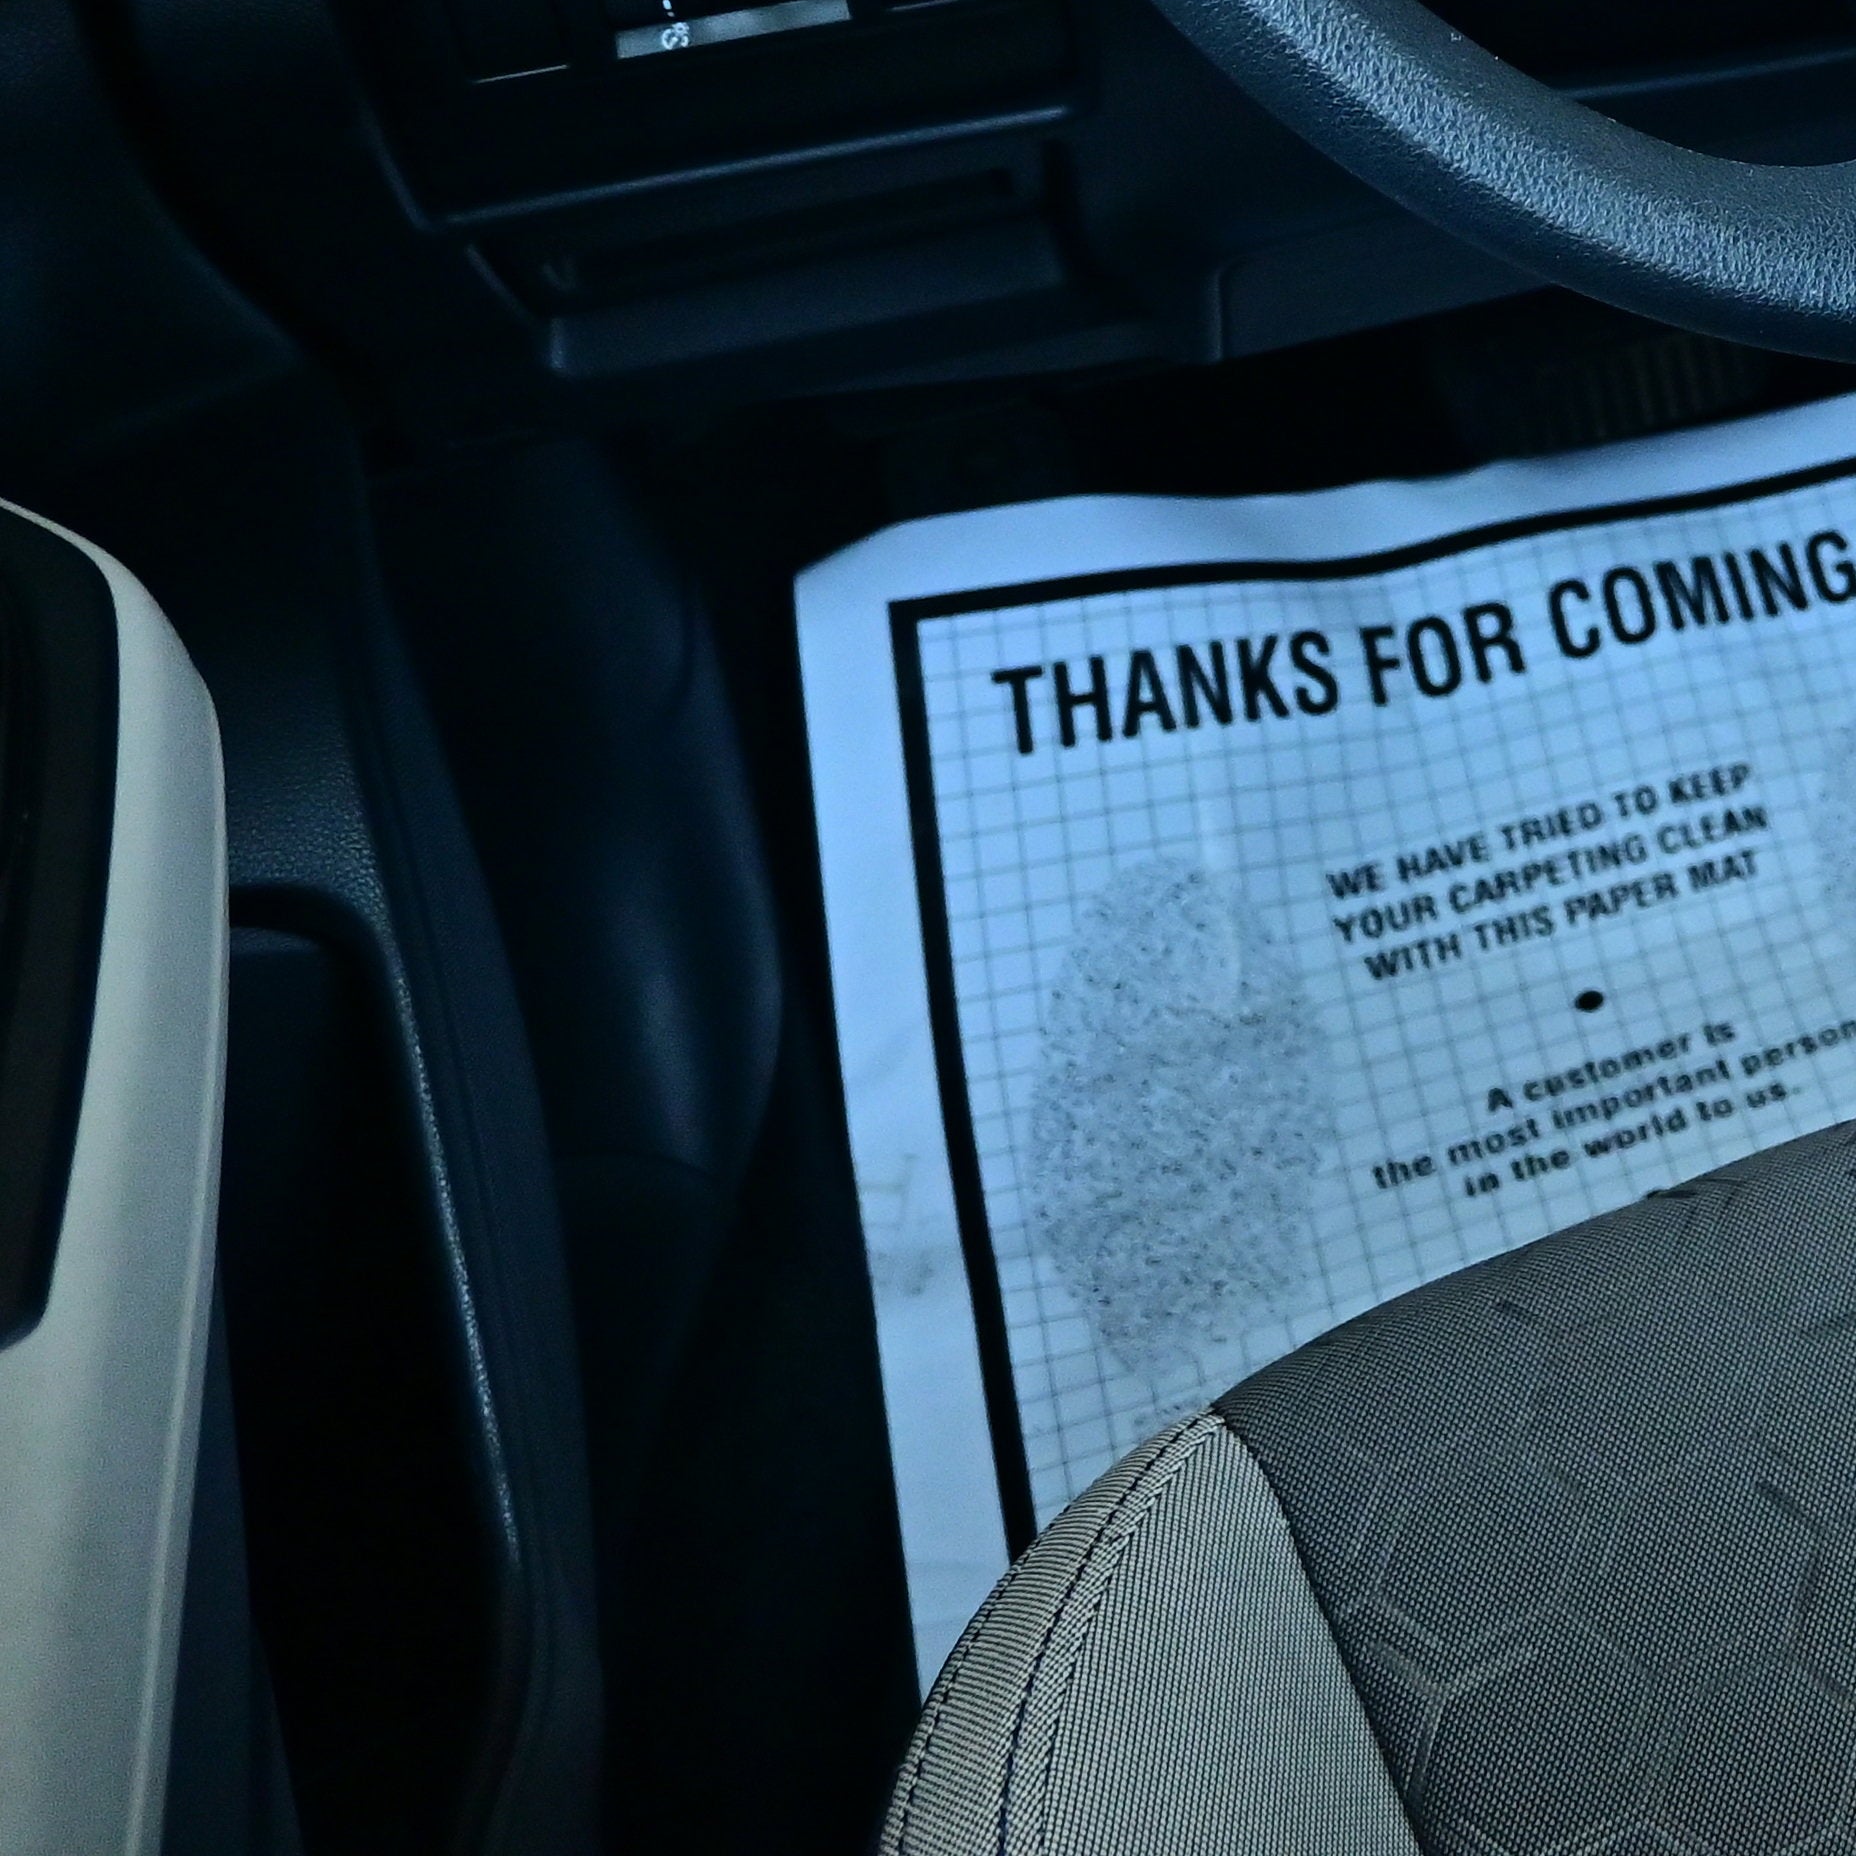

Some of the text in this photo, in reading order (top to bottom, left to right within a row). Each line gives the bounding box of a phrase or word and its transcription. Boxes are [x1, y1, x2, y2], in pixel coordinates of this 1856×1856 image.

[992, 628, 1340, 756] THANKS
[1362, 600, 1526, 707] FOR
[1326, 761, 1751, 899] WE HAVE TRIED TO KEEP
[1333, 804, 1768, 944] YOUR CARPETING CLEAN
[1364, 847, 1759, 981] WITH THIS PAPER MAT
[1372, 1151, 1435, 1190] the
[1447, 1118, 1540, 1167] most
[1551, 1058, 1731, 1132] important
[1486, 1020, 1737, 1112] A customer is
[1464, 1173, 1501, 1198] in
[1511, 1145, 1572, 1182] the
[1583, 1108, 1690, 1160] world
[1697, 1096, 1735, 1122] to
